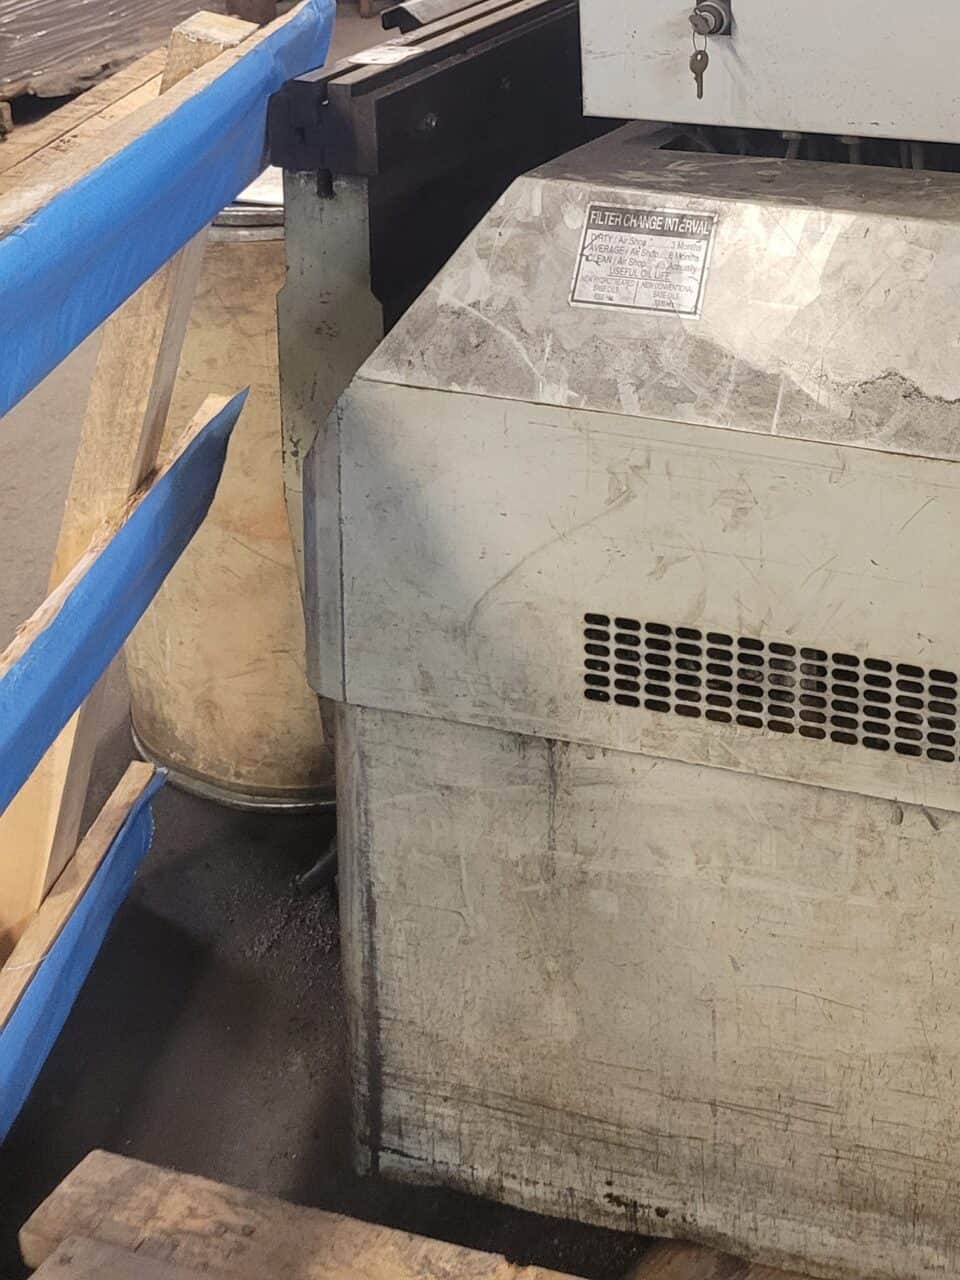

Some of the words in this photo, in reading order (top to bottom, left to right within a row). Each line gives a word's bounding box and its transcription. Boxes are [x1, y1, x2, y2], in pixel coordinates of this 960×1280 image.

[590, 210, 621, 226] FILTER
[623, 214, 663, 230] CHANGE
[664, 217, 709, 235] INTERVAL
[588, 243, 625, 254] AVERAGE
[609, 266, 640, 277] USEFUL
[641, 269, 653, 278] OIL
[655, 270, 672, 280] LIFE
